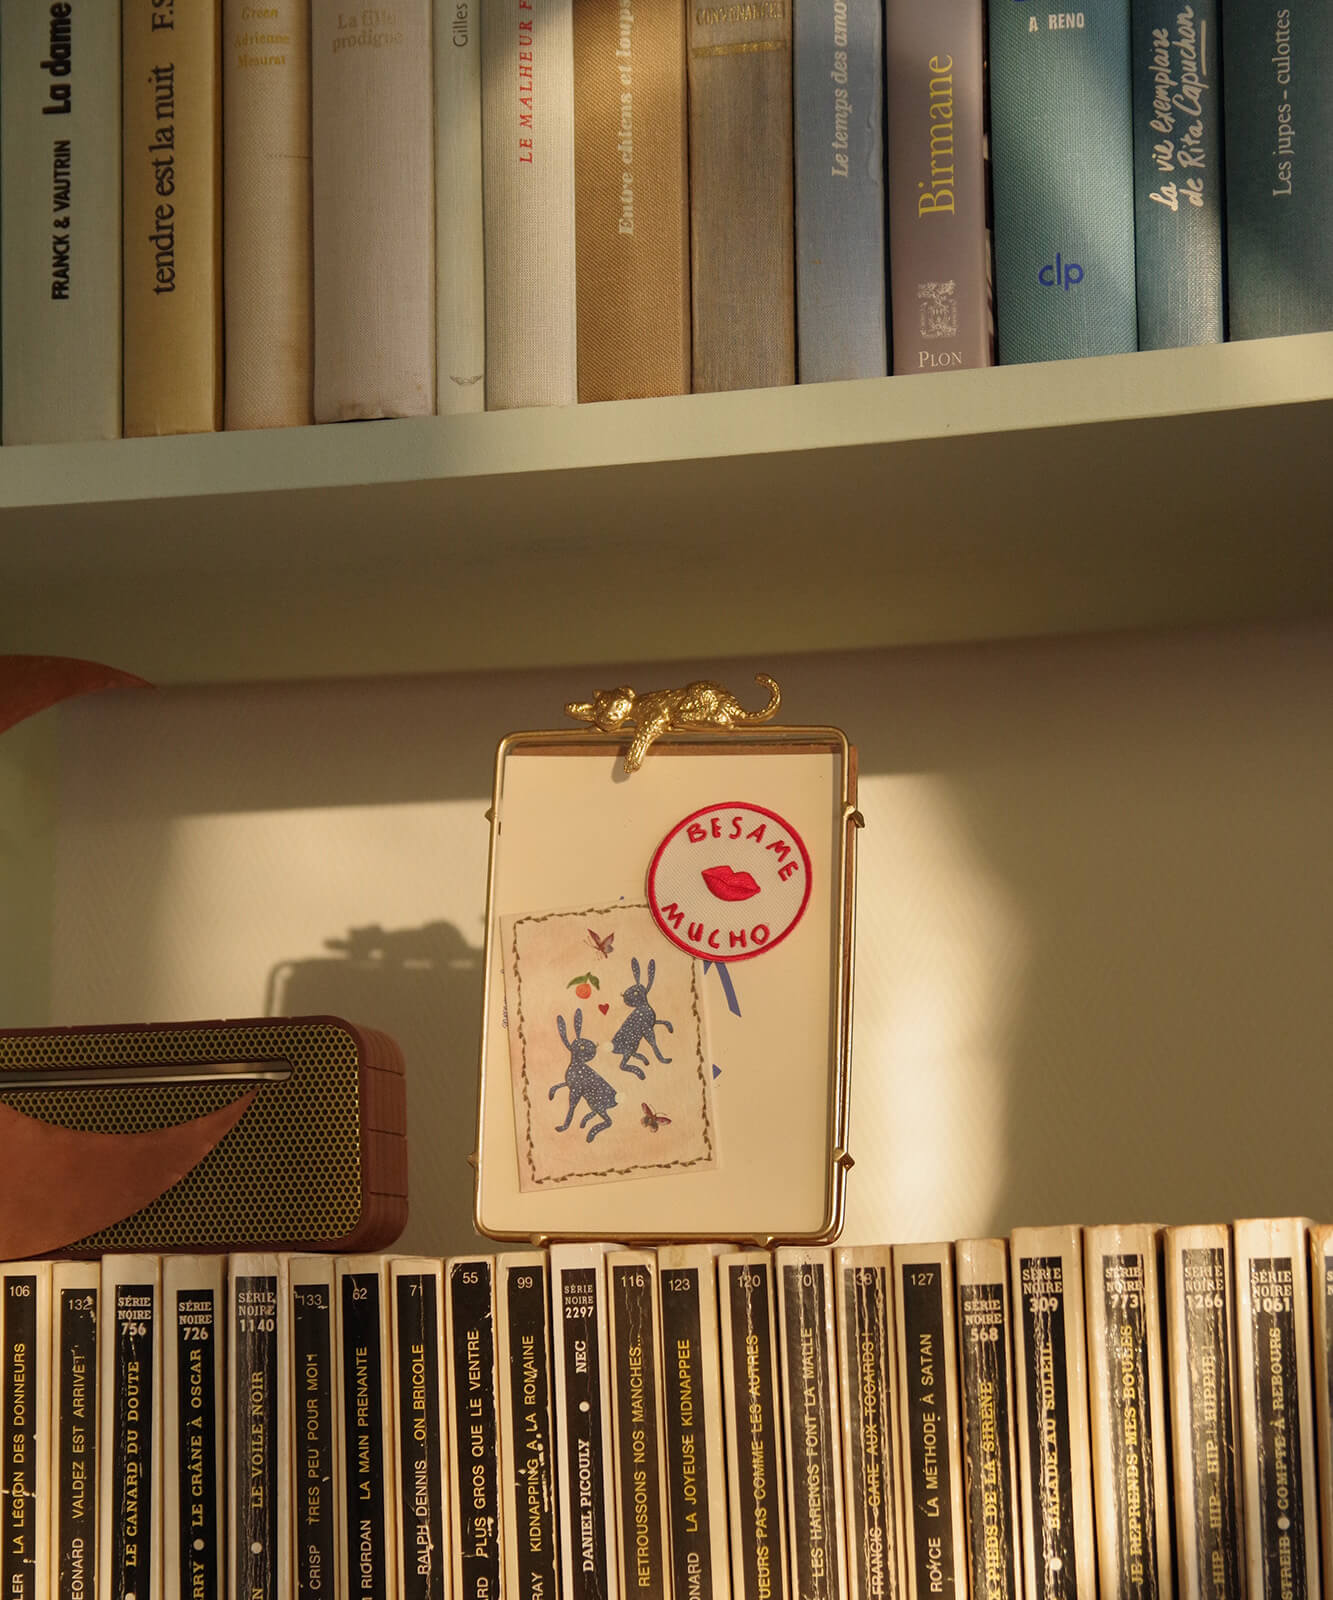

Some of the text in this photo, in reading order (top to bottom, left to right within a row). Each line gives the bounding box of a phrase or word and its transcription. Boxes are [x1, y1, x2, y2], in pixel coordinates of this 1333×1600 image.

[240, 8, 278, 20] Green
[336, 14, 358, 29] La
[453, 4, 468, 47] Gilles
[1028, 12, 1084, 32] A RENO
[616, 0, 634, 56] loups
[235, 32, 288, 48] Adrienne
[332, 31, 402, 54] prodigue
[238, 55, 286, 68] Mesurat
[618, 65, 632, 85] et
[520, 20, 534, 164] LE MALHEUR
[1272, 9, 1294, 197] Les jupes culottes
[831, 52, 852, 178] Le temps des
[1172, 6, 1208, 208] de Rita Capuchon
[617, 92, 634, 164] chiens
[918, 54, 955, 218] Birmane
[40, 2, 72, 299] FRANCK & VAUTRIN La dame
[1152, 141, 1175, 172] vie
[148, 62, 175, 295] tendre est la nuit
[1038, 252, 1084, 290] clp
[687, 816, 798, 882] BESAME
[662, 903, 770, 949] MUCHO
[462, 1272, 478, 1284] 55
[517, 1276, 533, 1290] 99
[621, 1276, 644, 1288] 116
[668, 1278, 690, 1291] 123
[737, 1276, 760, 1288] 120
[911, 1273, 934, 1286] 127
[1106, 1280, 1144, 1293] NOIRE
[1185, 1280, 1224, 1292] NOIRE
[1251, 1268, 1292, 1283] SÉRIE
[9, 1286, 30, 1297] 106
[238, 1291, 275, 1304] SÉRIE
[353, 1288, 368, 1300] 62
[410, 1284, 424, 1297] 71
[564, 1283, 593, 1294] SÉRIE
[1023, 1281, 1062, 1294] NOIRE
[1252, 1284, 1292, 1298] NOIRE
[68, 1299, 90, 1310] 132
[118, 1296, 151, 1307] SÉRIE
[178, 1300, 212, 1312] SÉRIE
[238, 1305, 275, 1316] NOIRE
[564, 1296, 594, 1305] NOIRE
[1029, 1296, 1058, 1312] 309
[1110, 1294, 1139, 1308] 773
[1186, 1294, 1224, 1308] 1266
[1253, 1298, 1291, 1312] 1061
[118, 1310, 152, 1320] NOIRE
[178, 1314, 212, 1325] NOIRE
[565, 1306, 594, 1319] 2297
[965, 1314, 1002, 1326] NOIRE
[122, 1322, 146, 1336] 756
[184, 1328, 208, 1340] 726
[240, 1318, 274, 1332] 1140
[970, 1328, 999, 1342] 568
[356, 1346, 369, 1428] PRENANTE
[307, 1399, 318, 1442] POUR
[1269, 1327, 1290, 1510] COMPTE À REBOURS
[72, 1426, 85, 1454] EST
[186, 1348, 204, 1527] LE CRÂNE À OSCAR
[252, 1370, 264, 1510] LE VOILE NOIR
[468, 1330, 488, 1557] PLUS GROS QUE LE VENTRE
[522, 1335, 543, 1552] KIDNAPPING A LA ROMAINE
[678, 1339, 698, 1533] LA JOYEUSE KIDNAPPEE
[746, 1334, 768, 1538] PAS COMME LES AUTRES
[1040, 1342, 1062, 1530] BALADE AU SOLEIL
[12, 1343, 26, 1554] LA LÉGION DES DONNEURS
[358, 1433, 370, 1473] MAIN
[412, 1344, 430, 1576] RALPH DENNIS ON BRICOLE
[576, 1340, 594, 1572] DANIEL PICOULY NEC
[800, 1327, 825, 1578] LES HARENGS FONT LA MALLE
[1120, 1324, 1145, 1586] JE REPRENDS MES BOULES
[126, 1361, 140, 1568] LE CANARD DU DOUTE
[308, 1449, 319, 1479] PEU
[629, 1335, 650, 1588] RETROUSSONS NOS MANCHES...
[920, 1334, 942, 1594] ROYCE LA MÉTHODE SATAN
[72, 1461, 84, 1519] VALDEZ
[360, 1481, 370, 1500] LA
[866, 1424, 884, 1596] FRANCIS GARE AUX
[983, 1460, 1001, 1582] PIEDS DE LA
[360, 1520, 372, 1590] RIORDAN
[310, 1544, 321, 1590] CRISP
